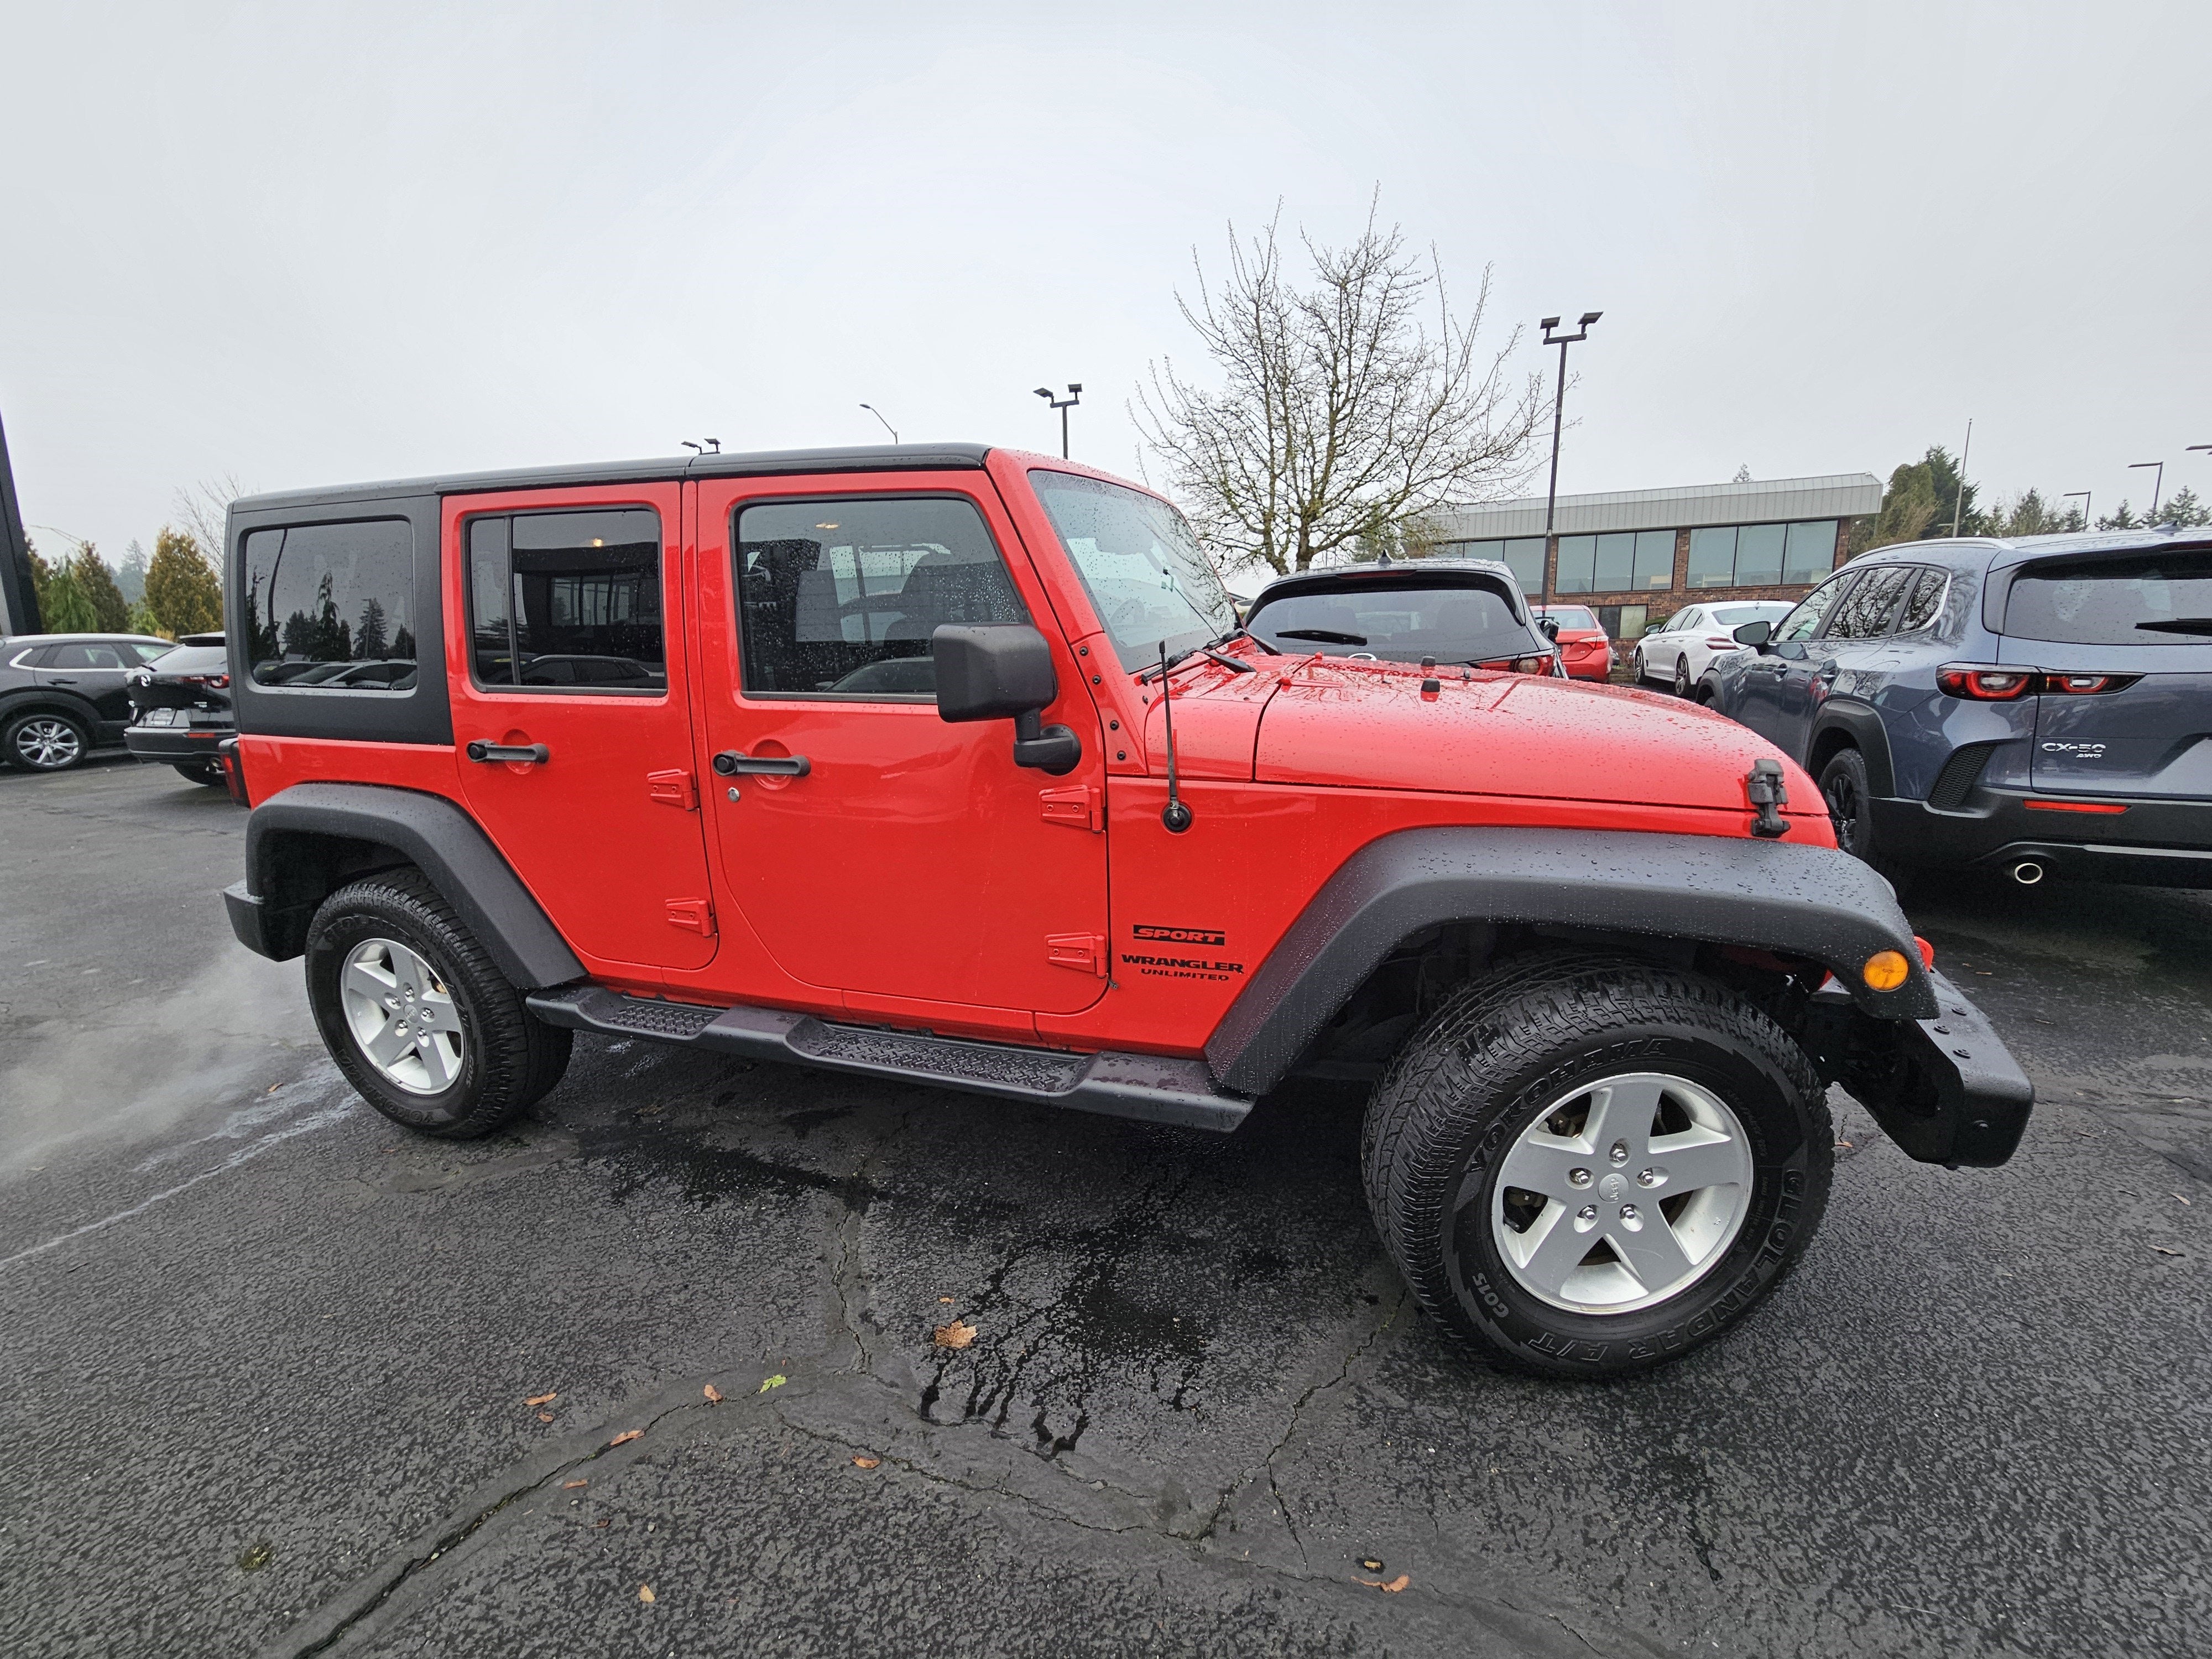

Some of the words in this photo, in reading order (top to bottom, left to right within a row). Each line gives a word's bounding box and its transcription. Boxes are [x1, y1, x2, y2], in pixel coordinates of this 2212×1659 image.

[2042, 742, 2106, 753] CX-50
[1135, 927, 1224, 943] SPORT
[1121, 954, 1244, 973] WRANGLER
[1141, 968, 1229, 981] UNLIMITED
[1464, 1038, 1672, 1173] YOKOHAMA
[1628, 1168, 1806, 1360] GEOLANDAR
[1473, 1272, 1510, 1319] G015
[1528, 1332, 1608, 1362] A/T
